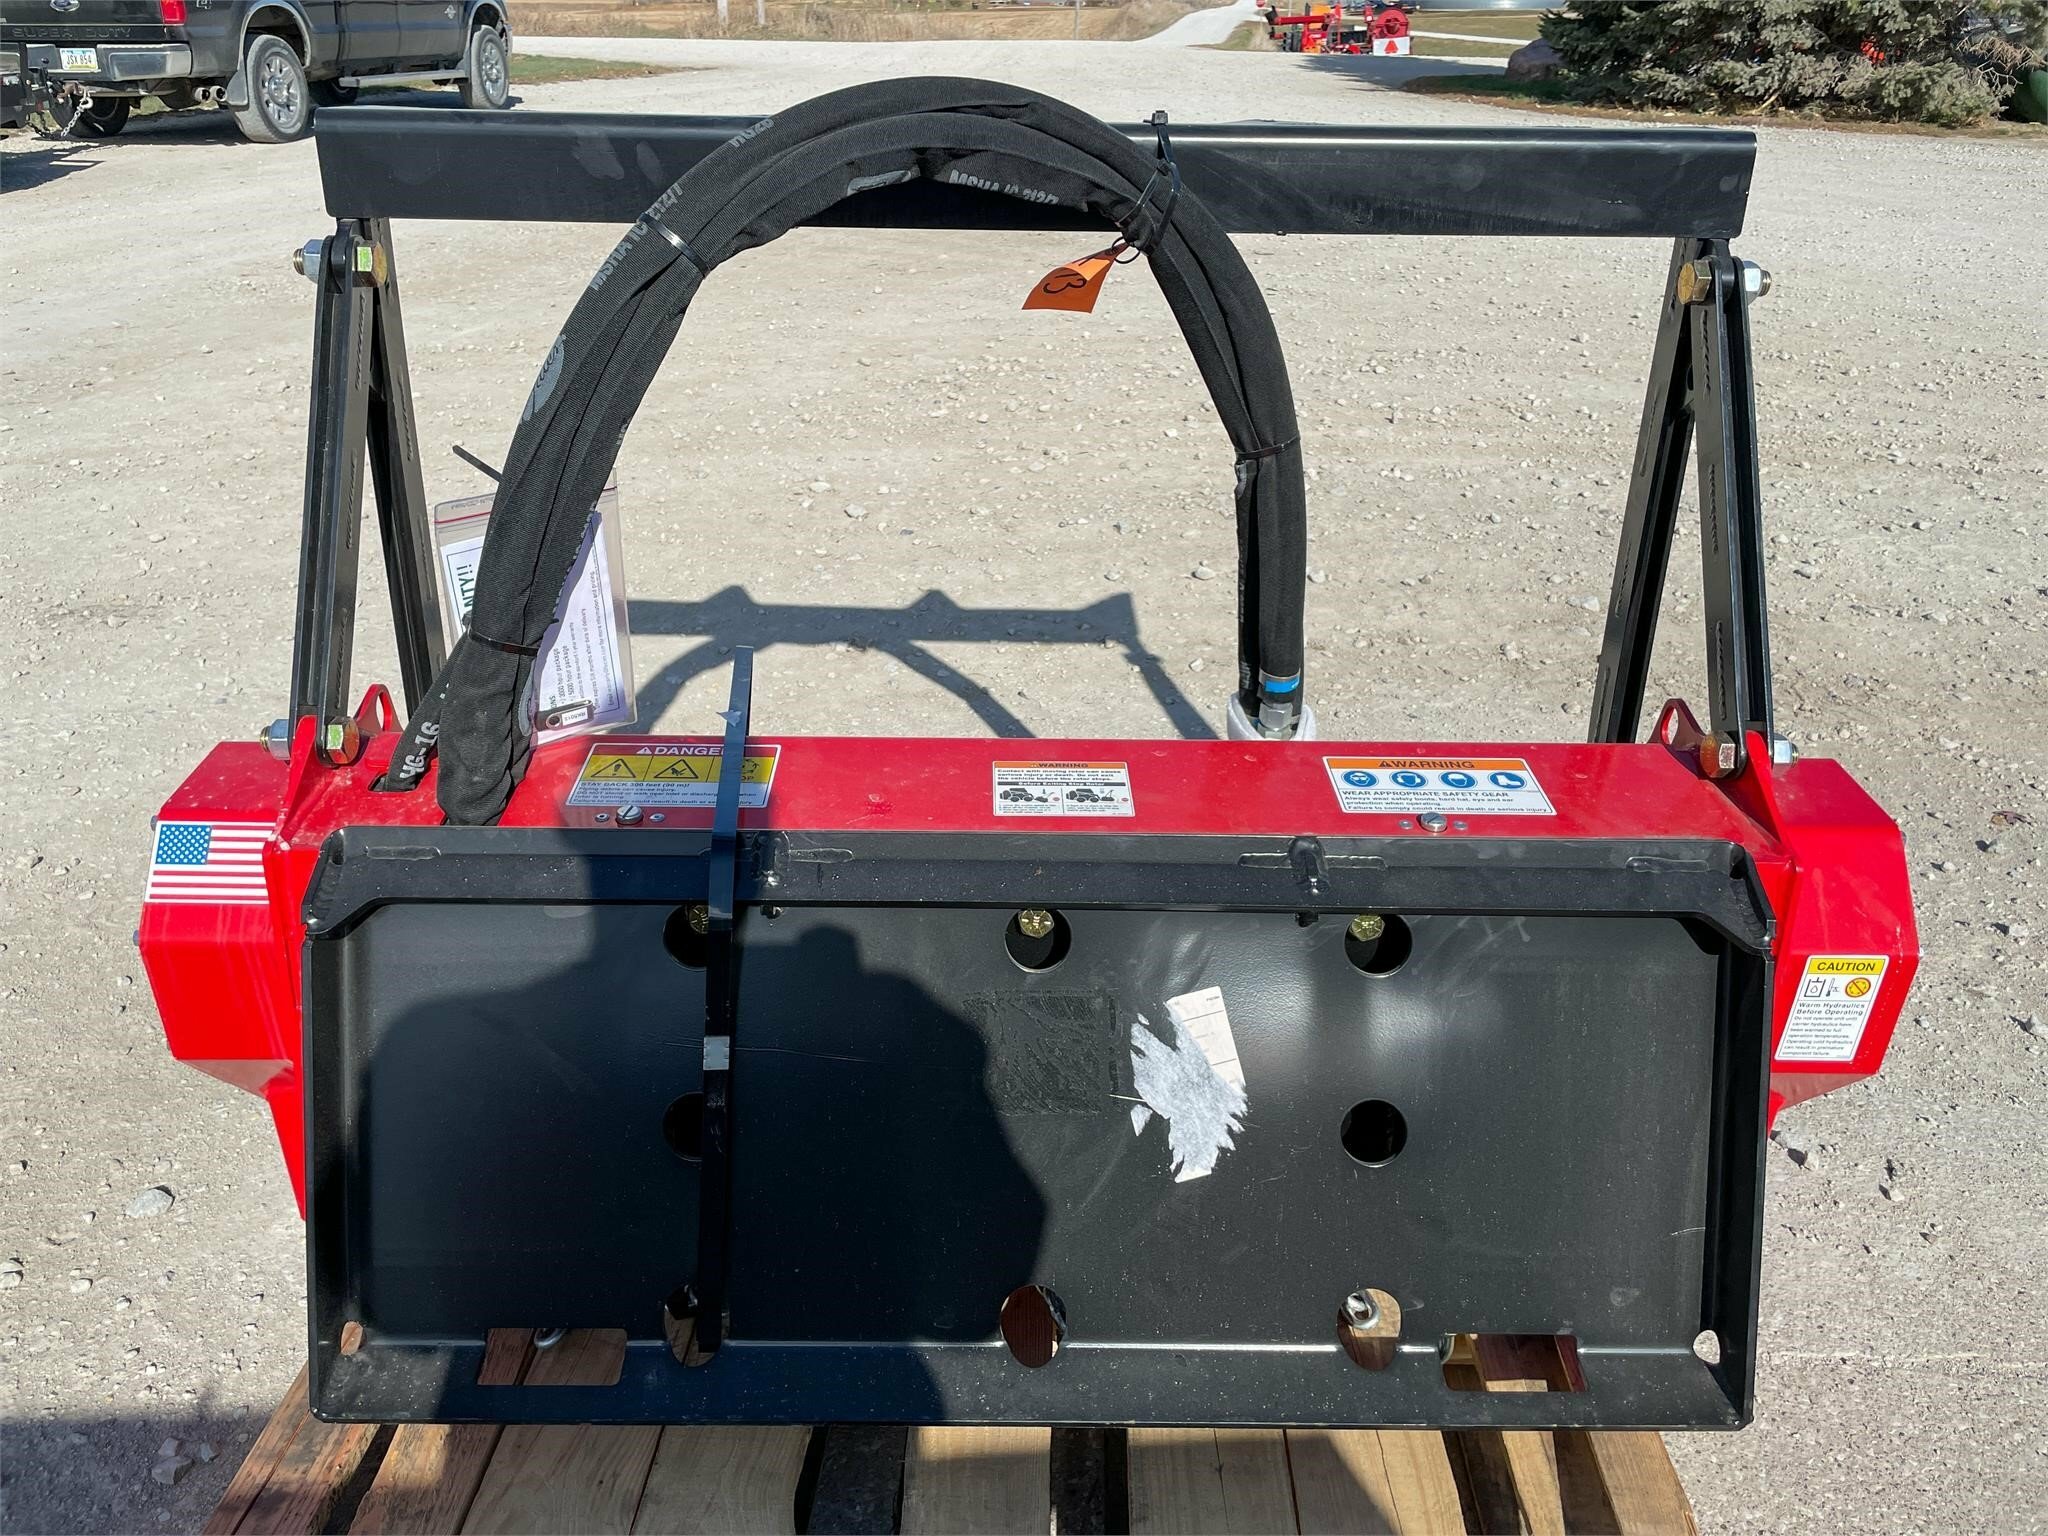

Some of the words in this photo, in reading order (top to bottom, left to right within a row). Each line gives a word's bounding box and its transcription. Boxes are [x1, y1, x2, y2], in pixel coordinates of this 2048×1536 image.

[12, 28, 72, 38] SUPER
[86, 27, 132, 38] DUTY
[654, 746, 724, 755] DANGE
[1390, 760, 1474, 768] WARNING
[1817, 962, 1876, 971] CAUTION
